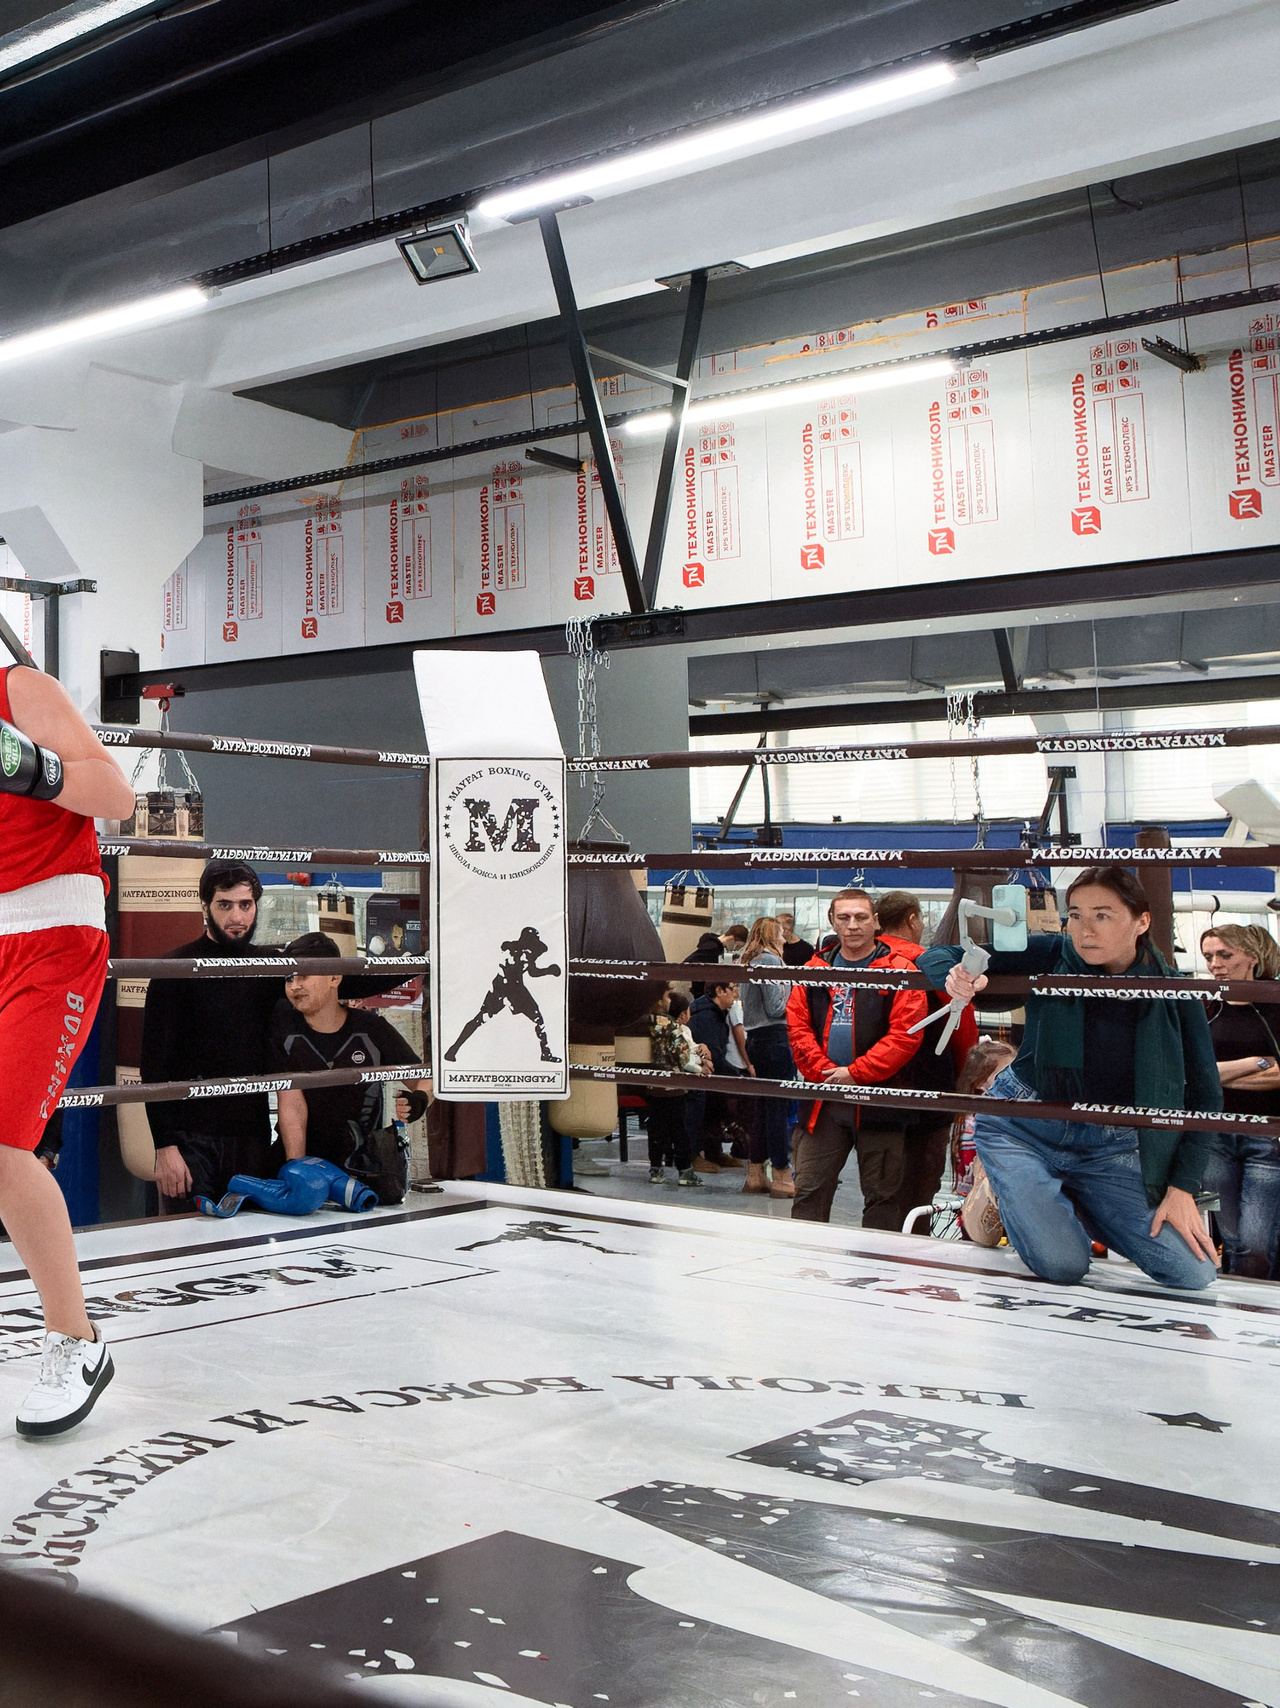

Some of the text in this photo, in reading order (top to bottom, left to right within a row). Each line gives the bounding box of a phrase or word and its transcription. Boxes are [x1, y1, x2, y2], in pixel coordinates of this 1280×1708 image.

[1228, 349, 1251, 485] ТЕХНОНИКОЛЬ
[1071, 373, 1091, 503] ТЕХНОНИКОЛЬ
[1263, 425, 1276, 478] MASTER
[802, 422, 817, 540] ТЕХНОНИКОЛЬ
[928, 401, 946, 524] ТЕХНОНИКОЛЬ
[1102, 446, 1114, 496] MASTER
[685, 446, 698, 559] ТЕХНОНИКОЛЬ
[826, 489, 835, 534] MASTER
[956, 470, 966, 518] MASTER
[480, 485, 490, 590] ТЕХНОНИКОЛЬ
[577, 471, 588, 573] ТЕХНОНИКОЛ
[706, 511, 715, 554] MASTER
[305, 519, 314, 615] ТЕХНОНИКОЛЬ
[389, 499, 399, 599] ТЕХНОНИКОЛЬ
[226, 526, 235, 619] ТЕХНОНИКОЛЬ
[4, 731, 13, 771] GREEN
[11, 744, 20, 767] HILL
[211, 739, 312, 757] MAYFATBOXINGGYM
[378, 751, 430, 765] MAYFATBOX
[754, 748, 909, 765] MAYFATBOXINGGYM
[1035, 733, 1227, 752] MAYFATBOXINGGYM
[448, 766, 555, 802] MAYFAT BOXING GYM
[462, 798, 541, 852] M
[211, 848, 312, 862] MAYFATBOXINGGYM
[378, 852, 430, 863] BOXINGGYM
[448, 843, 471, 870] ШКОЛА
[472, 865, 498, 880] БОКСА
[568, 852, 646, 863] MAYFATBOX
[750, 850, 904, 863] MAYFATBOXINGGYM
[1031, 847, 1222, 860] MAYFATBOXINGGYM
[188, 1078, 293, 1098] MAYFATBOXINGGYM
[359, 1068, 434, 1084] FATBOXINGGYM
[448, 1073, 556, 1083] MAYFATBOXINGGYM
[1071, 1101, 1269, 1124] MAYFATBOXINGGYM
[209, 1408, 309, 1434] И
